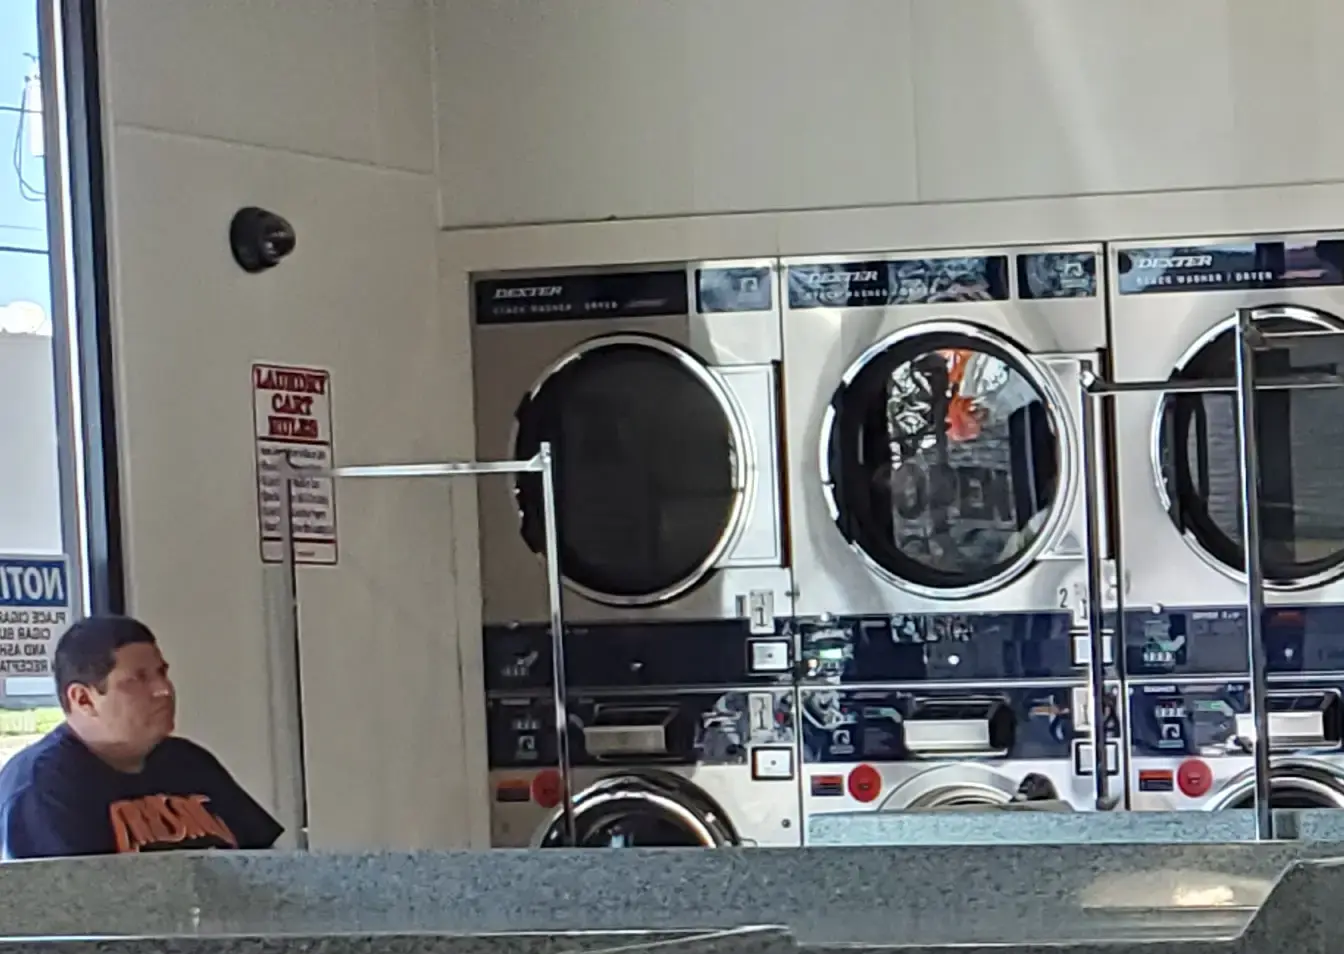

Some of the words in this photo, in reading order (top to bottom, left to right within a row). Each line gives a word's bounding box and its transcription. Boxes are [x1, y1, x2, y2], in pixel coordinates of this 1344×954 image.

[1136, 254, 1213, 269] DEXTER
[808, 269, 879, 284] DEXTER
[1177, 272, 1222, 285] WASHER
[494, 285, 563, 299] DEXTER
[256, 367, 326, 396] LAUNDRY
[272, 392, 313, 415] CART
[268, 415, 318, 439] RULES
[1059, 587, 1069, 609] 2
